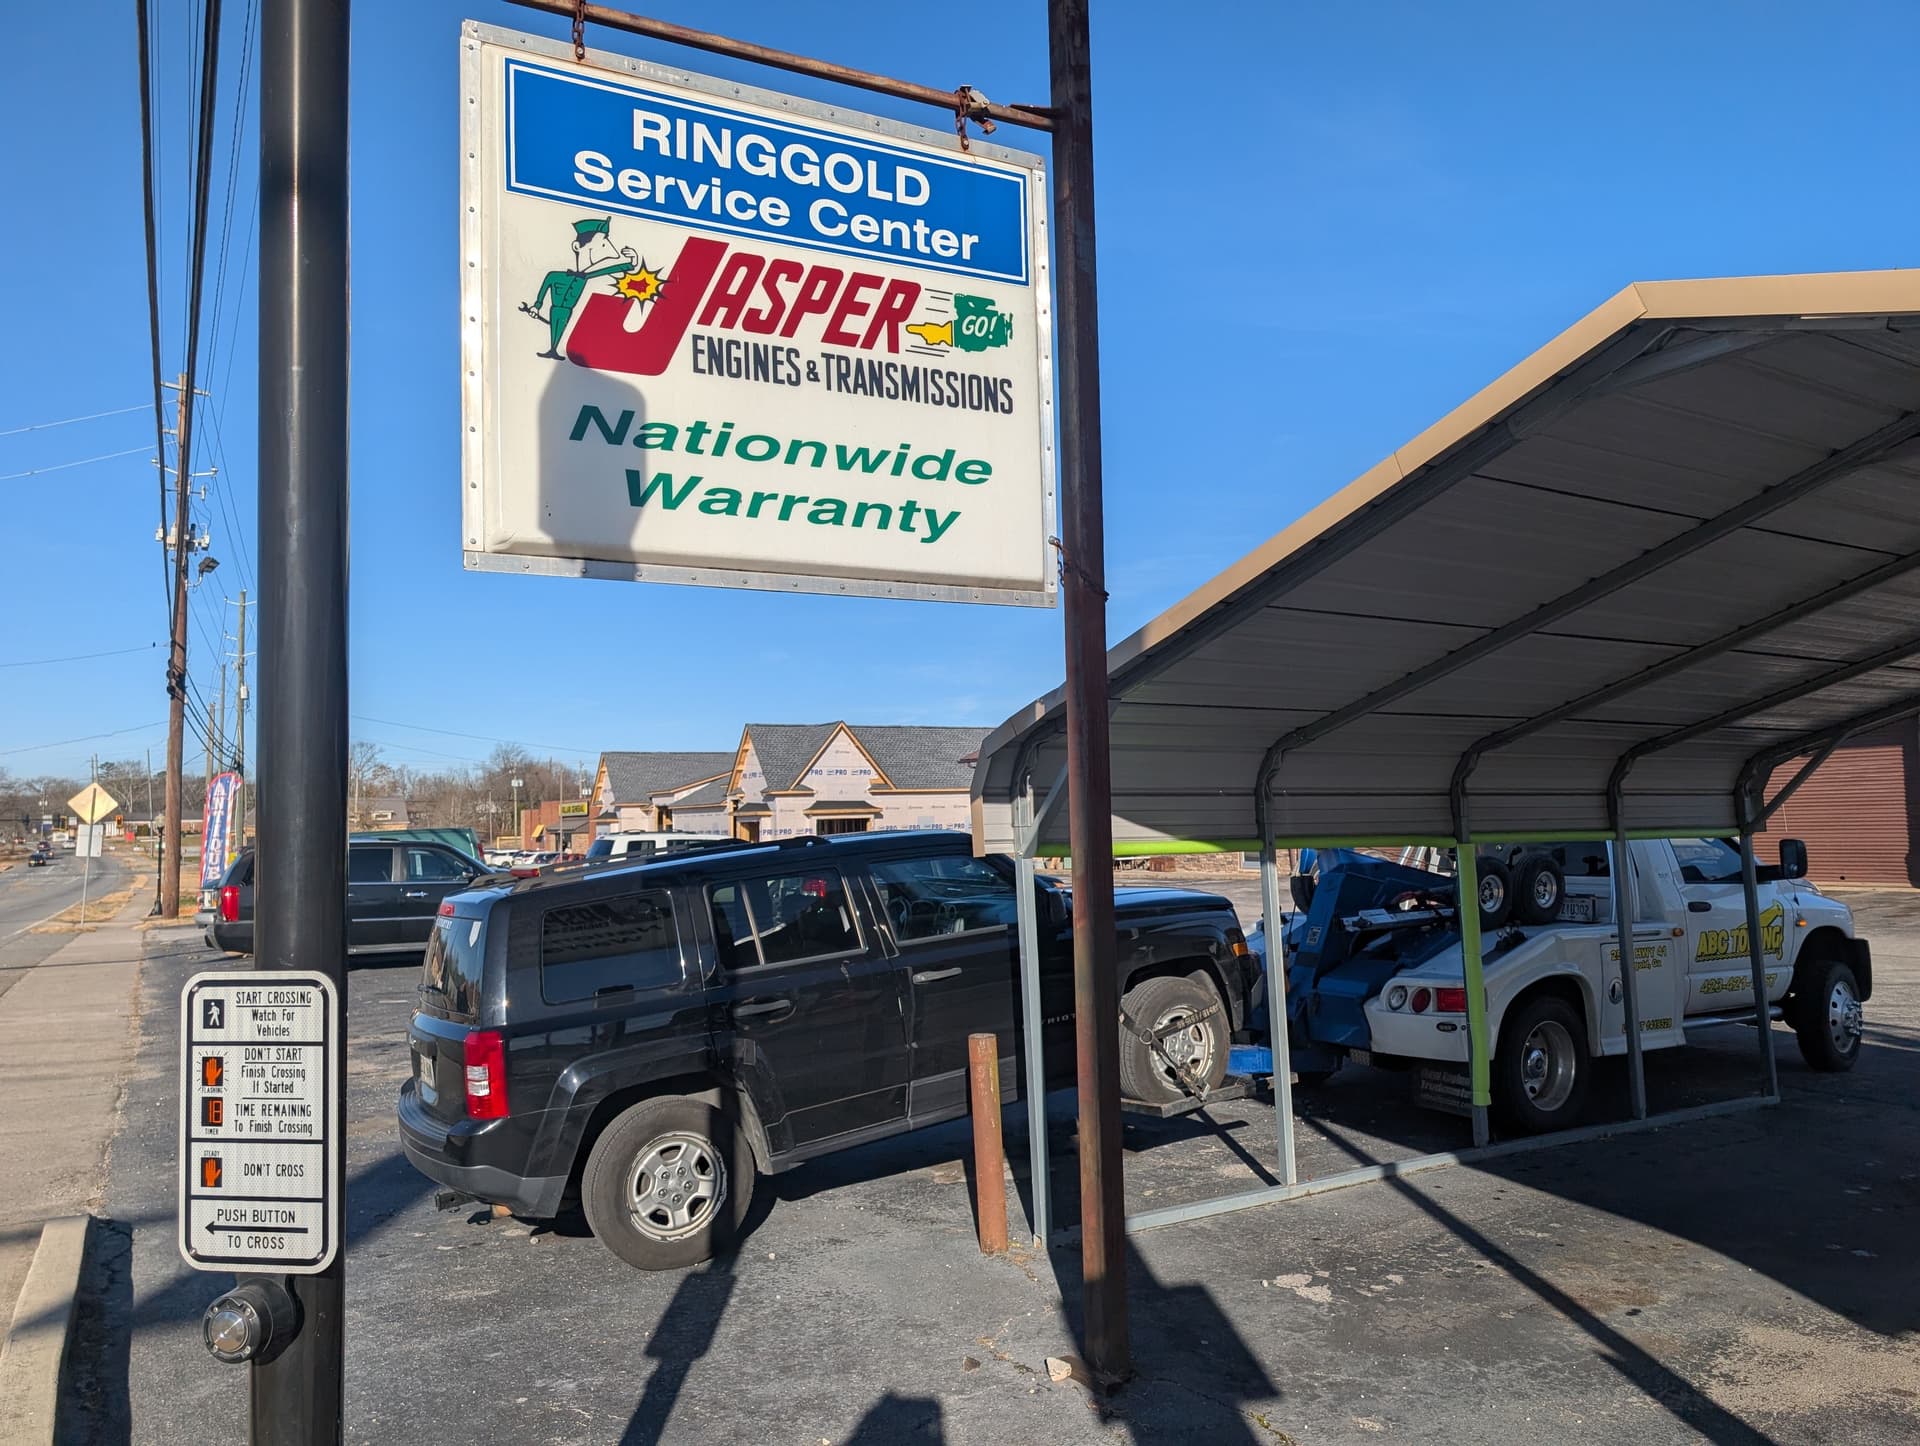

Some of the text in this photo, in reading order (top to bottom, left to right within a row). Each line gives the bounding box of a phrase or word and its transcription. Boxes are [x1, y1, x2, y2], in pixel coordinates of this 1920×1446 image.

[632, 109, 930, 207] RINGGOLD
[573, 150, 979, 260] Service Center
[566, 236, 922, 377] JASPER
[962, 313, 997, 340] GO!
[692, 334, 1014, 415] ENGINES & TRANSMISSIONS
[569, 405, 993, 486] Nationwide
[624, 468, 962, 544] Warranty
[1697, 929, 1730, 957] ABC
[235, 991, 312, 1004] START CROSSING
[251, 1009, 295, 1022] Watch For
[257, 1024, 290, 1037] Vehicles
[244, 1047, 302, 1061] DON'T START
[241, 1065, 306, 1082] Finish Crossing
[202, 1086, 223, 1094] FLASHING
[252, 1081, 294, 1094] If Started
[235, 1103, 312, 1117] TIME REMAINING
[204, 1128, 219, 1136] TIMER
[234, 1120, 313, 1137] To Finish Crossing
[243, 1163, 304, 1178] DON'T CROSS
[217, 1208, 296, 1223] PUSH BUTTON
[227, 1235, 285, 1249] TO CROSS
